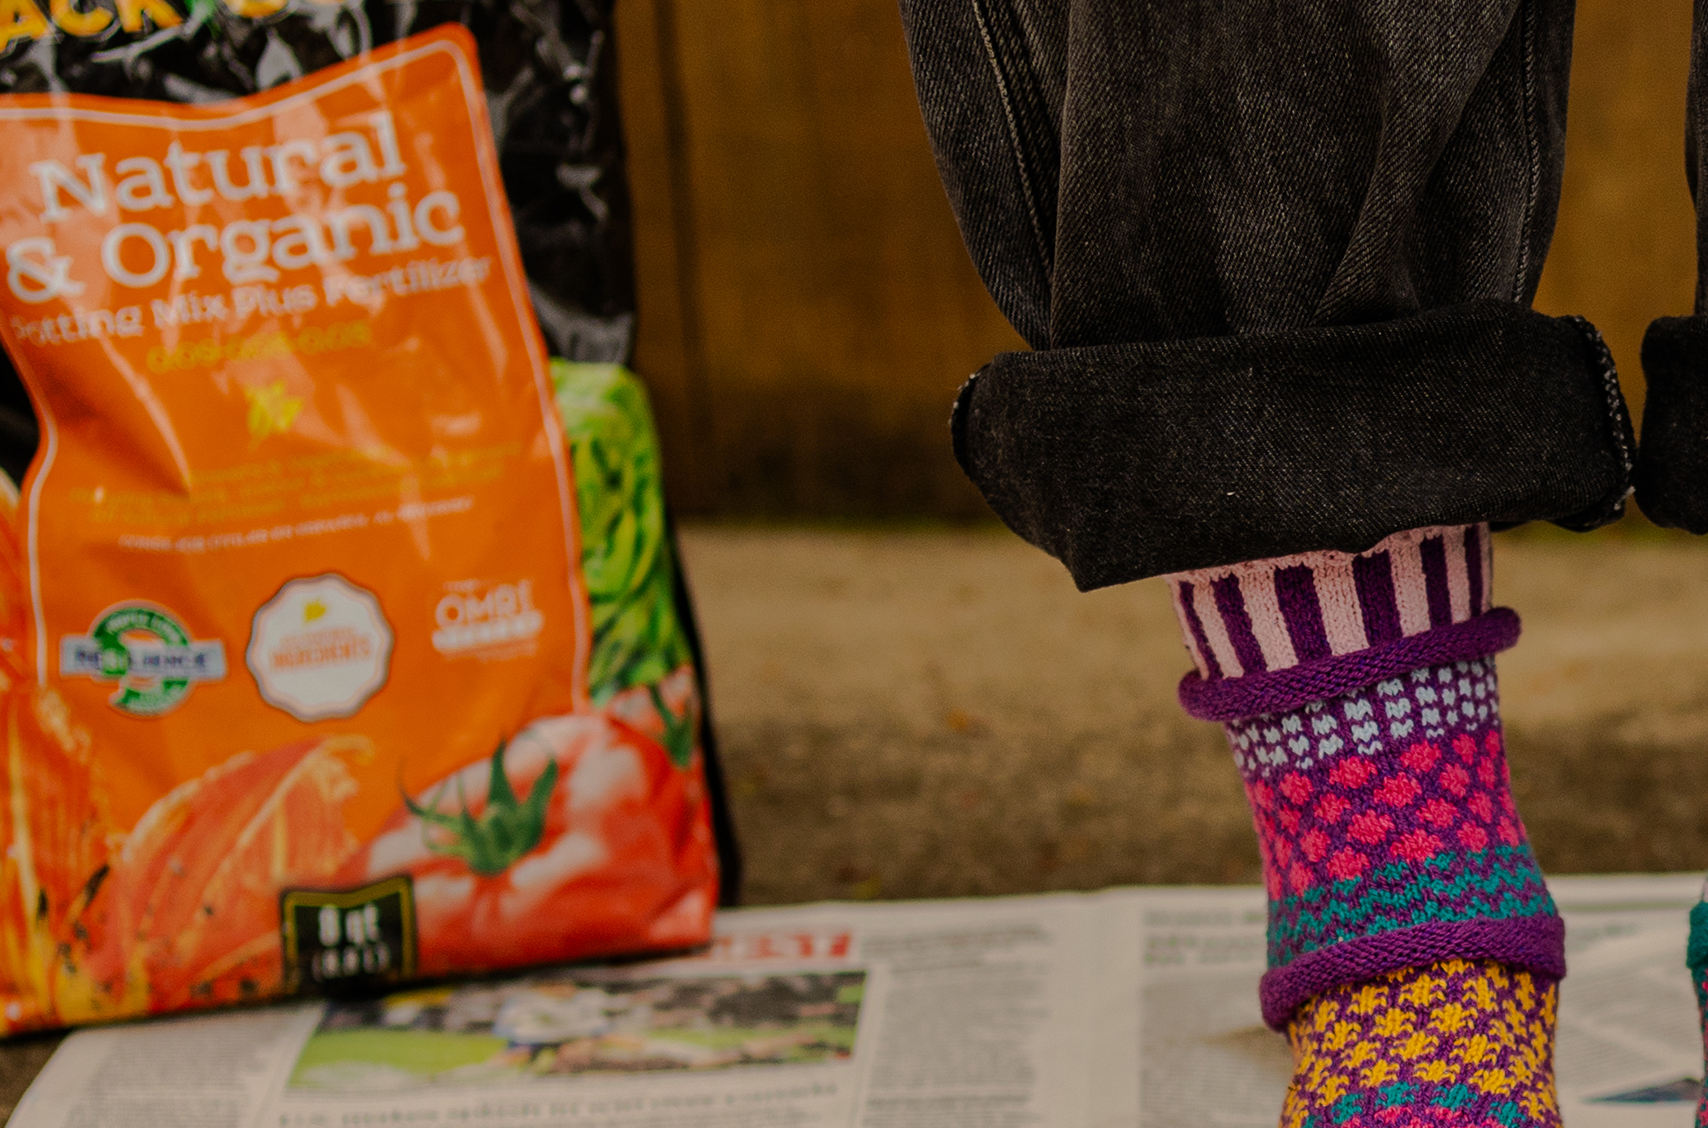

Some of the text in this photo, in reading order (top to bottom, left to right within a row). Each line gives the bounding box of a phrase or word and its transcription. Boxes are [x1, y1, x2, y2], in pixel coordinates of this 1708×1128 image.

[29, 111, 406, 224] Natural
[6, 184, 466, 303] & Organic
[151, 294, 227, 328] Mix
[232, 285, 316, 317] Plus
[324, 256, 491, 307] Fertilizer
